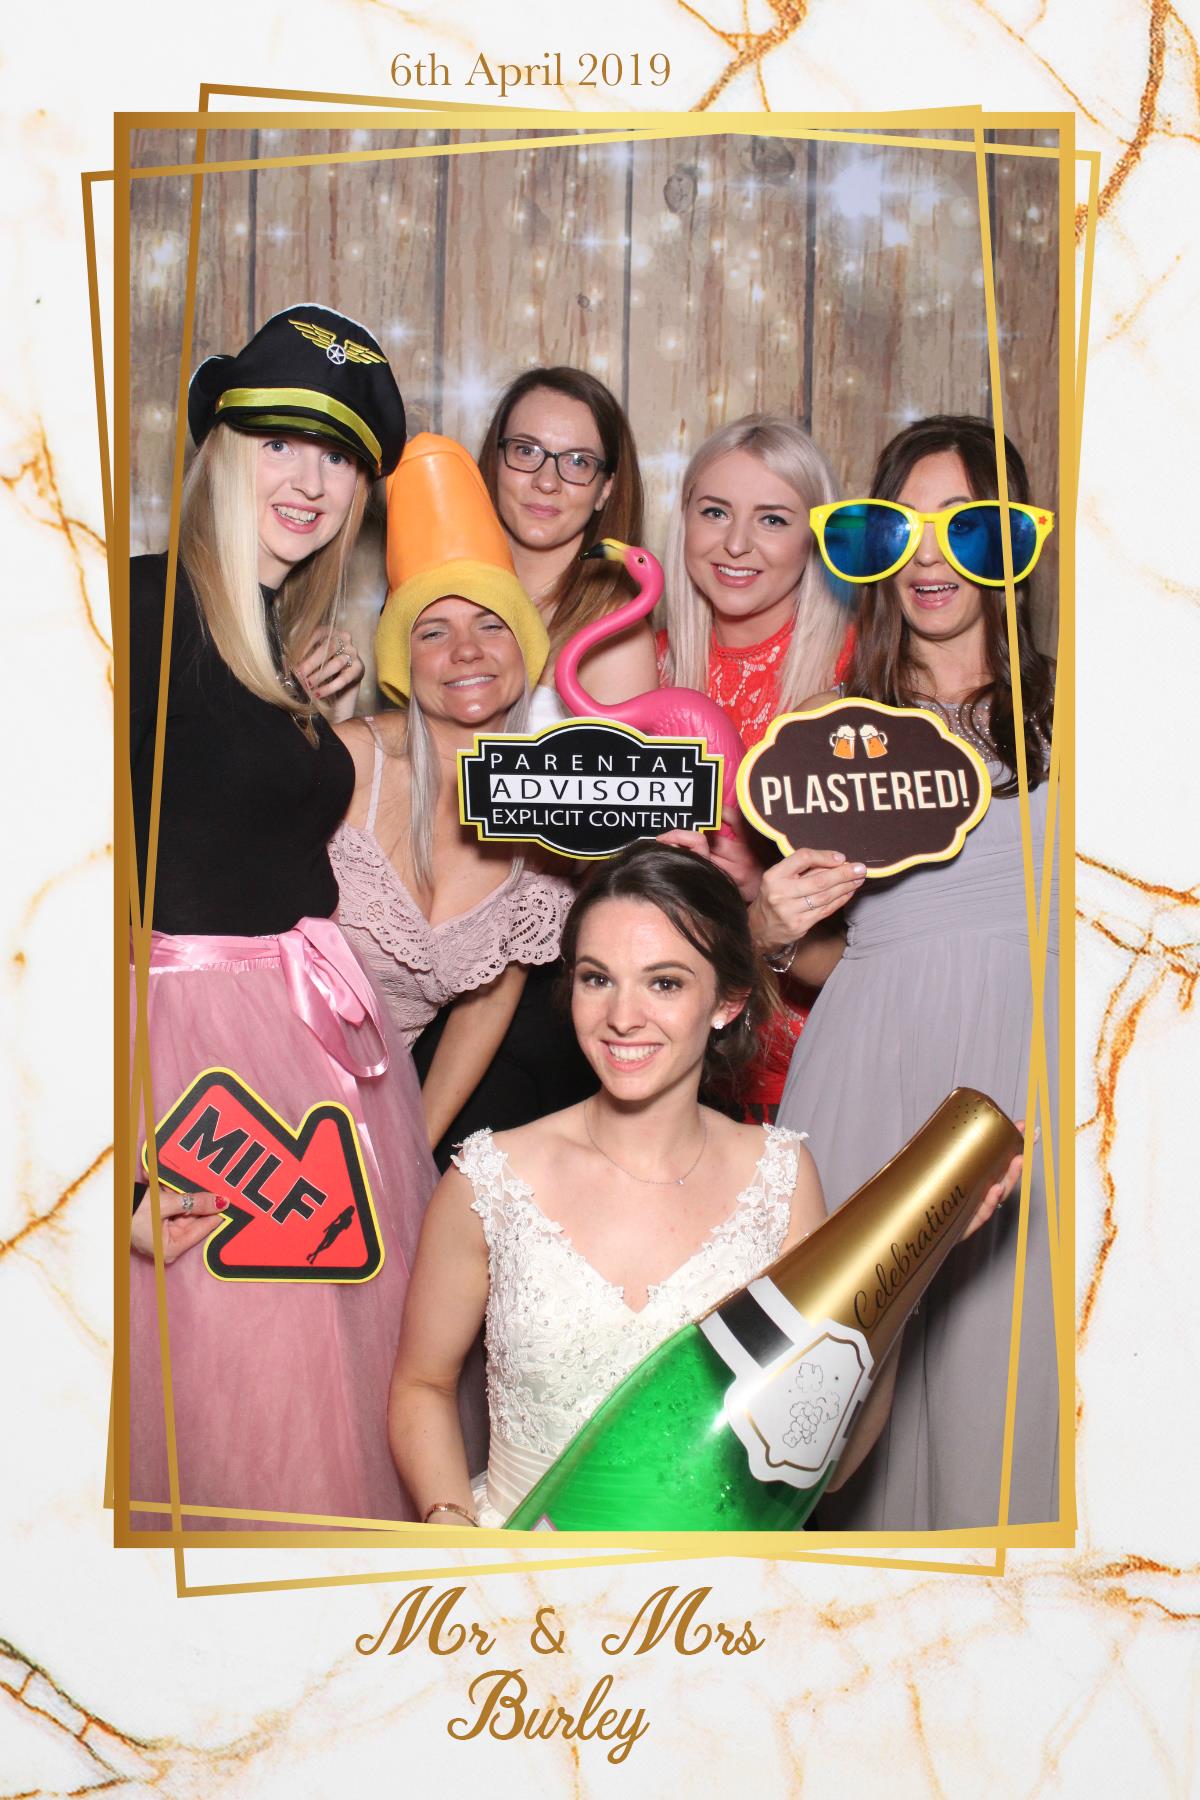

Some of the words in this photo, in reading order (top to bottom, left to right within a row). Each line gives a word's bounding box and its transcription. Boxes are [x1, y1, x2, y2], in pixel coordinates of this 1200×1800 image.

[490, 753, 693, 773] PARENTAL
[491, 778, 693, 803] ADVISORY
[760, 769, 970, 816] PLASTERED!
[492, 808, 583, 826] EXPLICIT
[589, 810, 693, 829] CONTENT
[177, 1104, 329, 1225] MILF
[853, 1183, 966, 1331] Celebration
